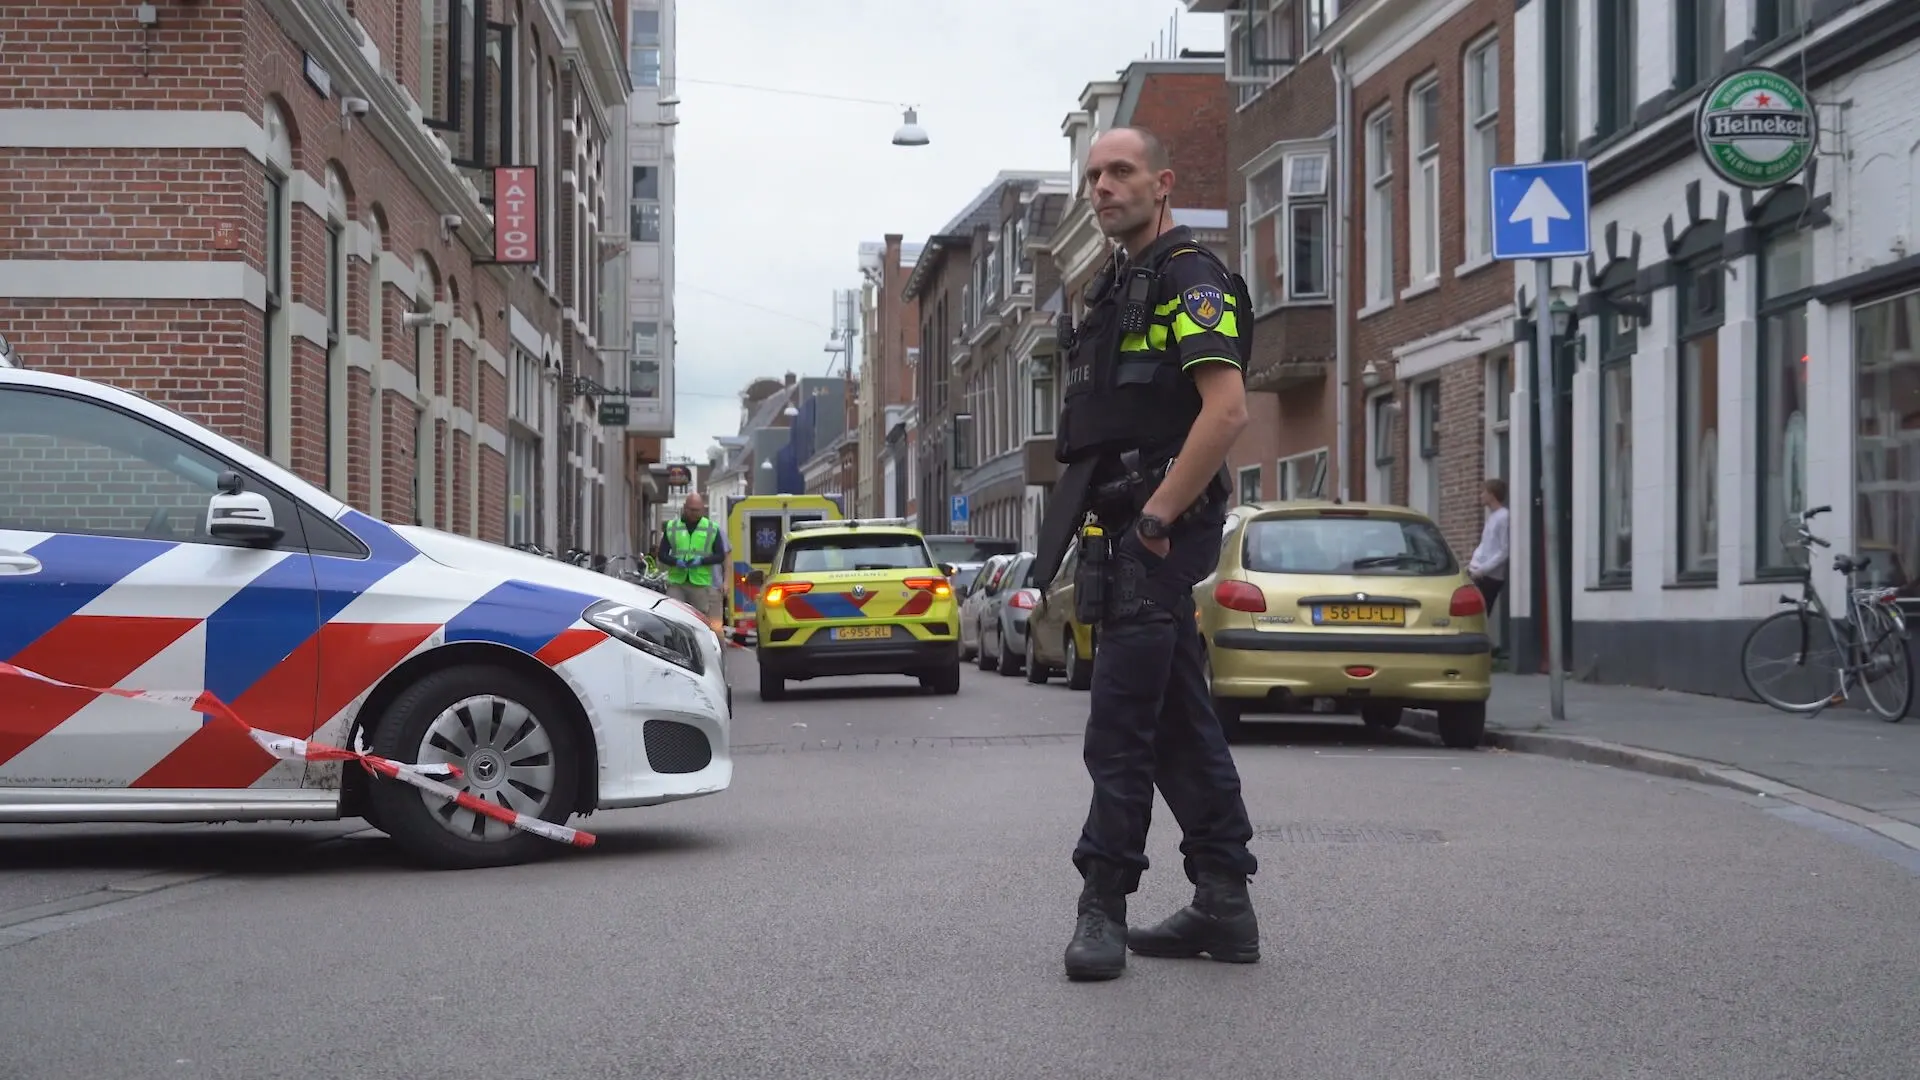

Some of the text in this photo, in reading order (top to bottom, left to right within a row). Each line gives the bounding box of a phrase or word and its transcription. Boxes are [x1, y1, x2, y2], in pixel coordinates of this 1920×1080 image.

[1715, 115, 1806, 134] Heineken
[504, 169, 528, 259] TATTOO
[1187, 291, 1221, 300] POLITIE
[1330, 606, 1396, 620] 58-LJ-LJ
[839, 625, 888, 638] G-955-RL
